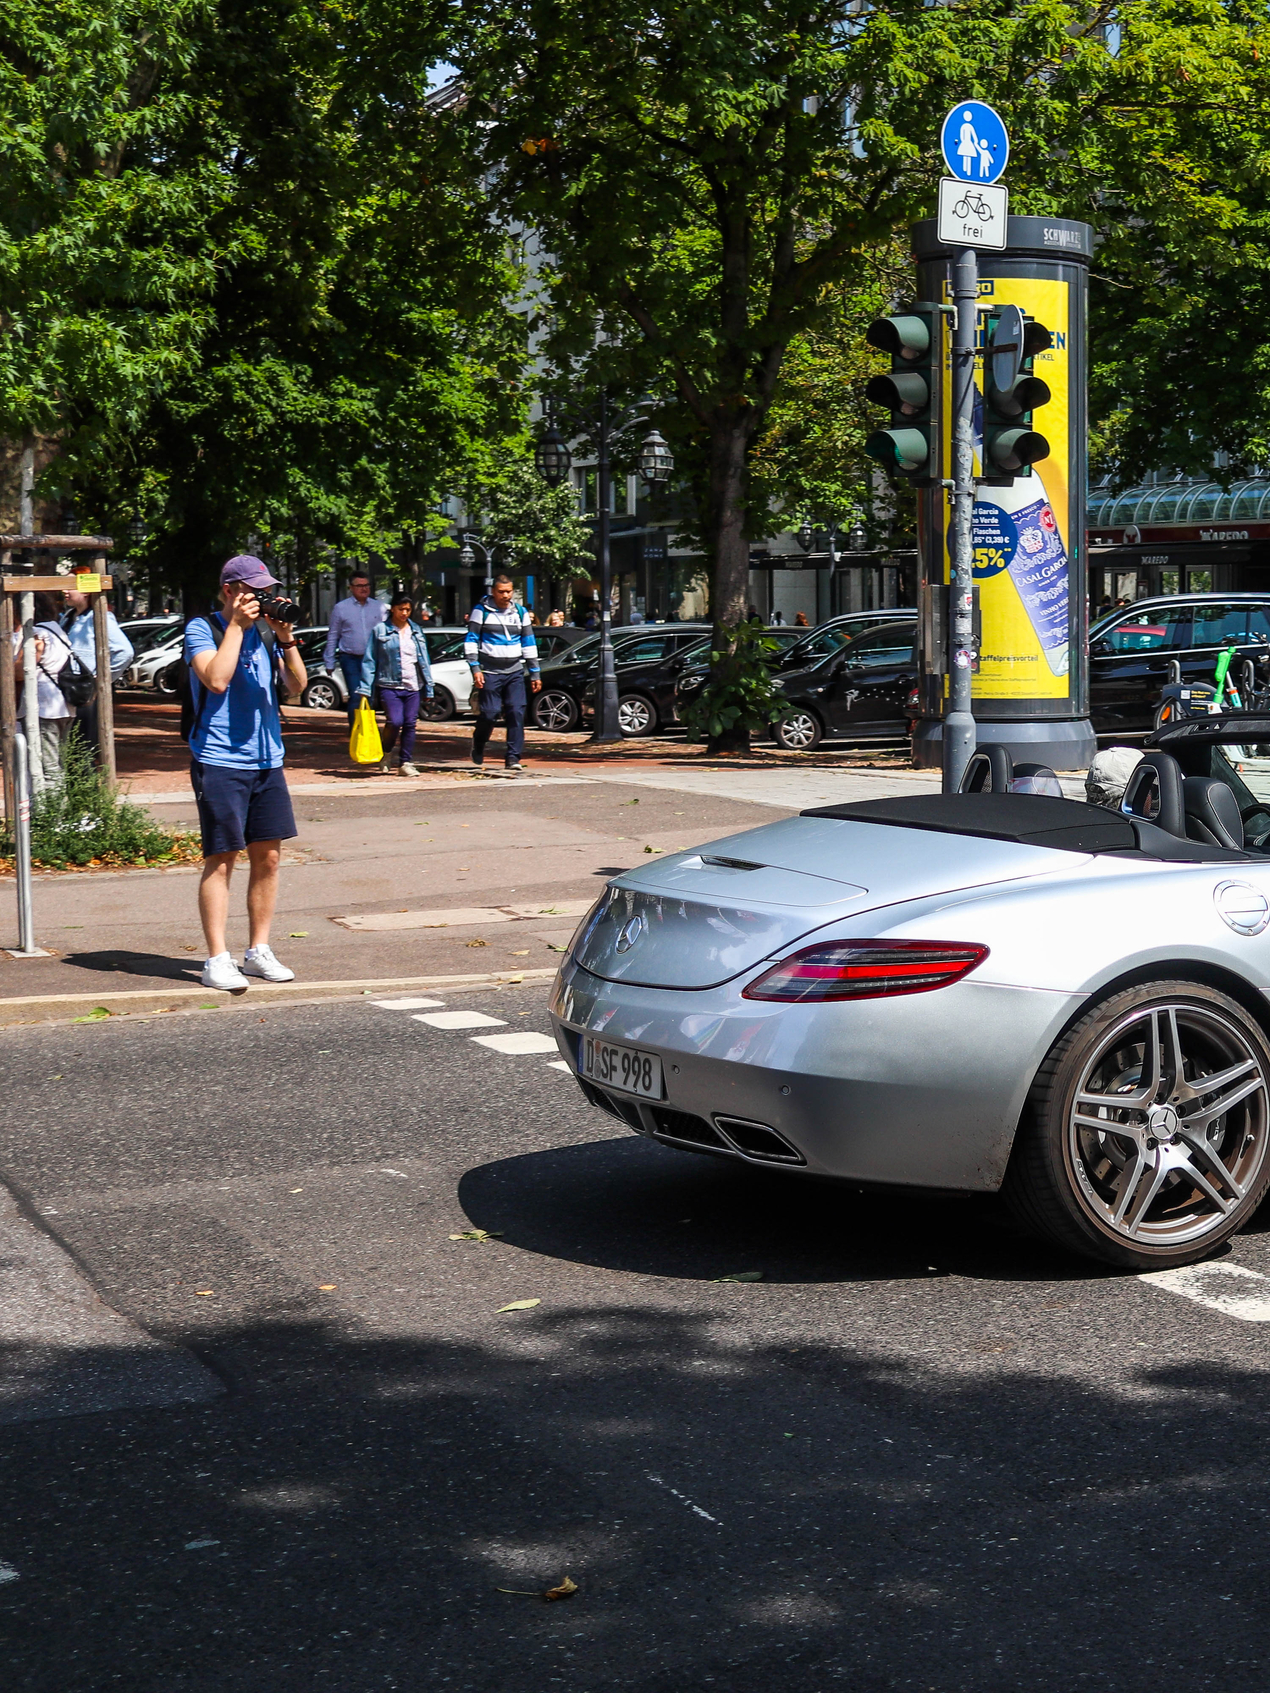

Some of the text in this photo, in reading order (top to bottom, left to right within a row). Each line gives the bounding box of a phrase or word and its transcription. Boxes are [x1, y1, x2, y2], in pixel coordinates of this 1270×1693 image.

[962, 223, 984, 238] frei
[978, 507, 999, 515] Garcia
[979, 516, 999, 524] Verde
[979, 654, 1039, 663] taffelpreisvorteil
[586, 1039, 653, 1092] D SF 998
